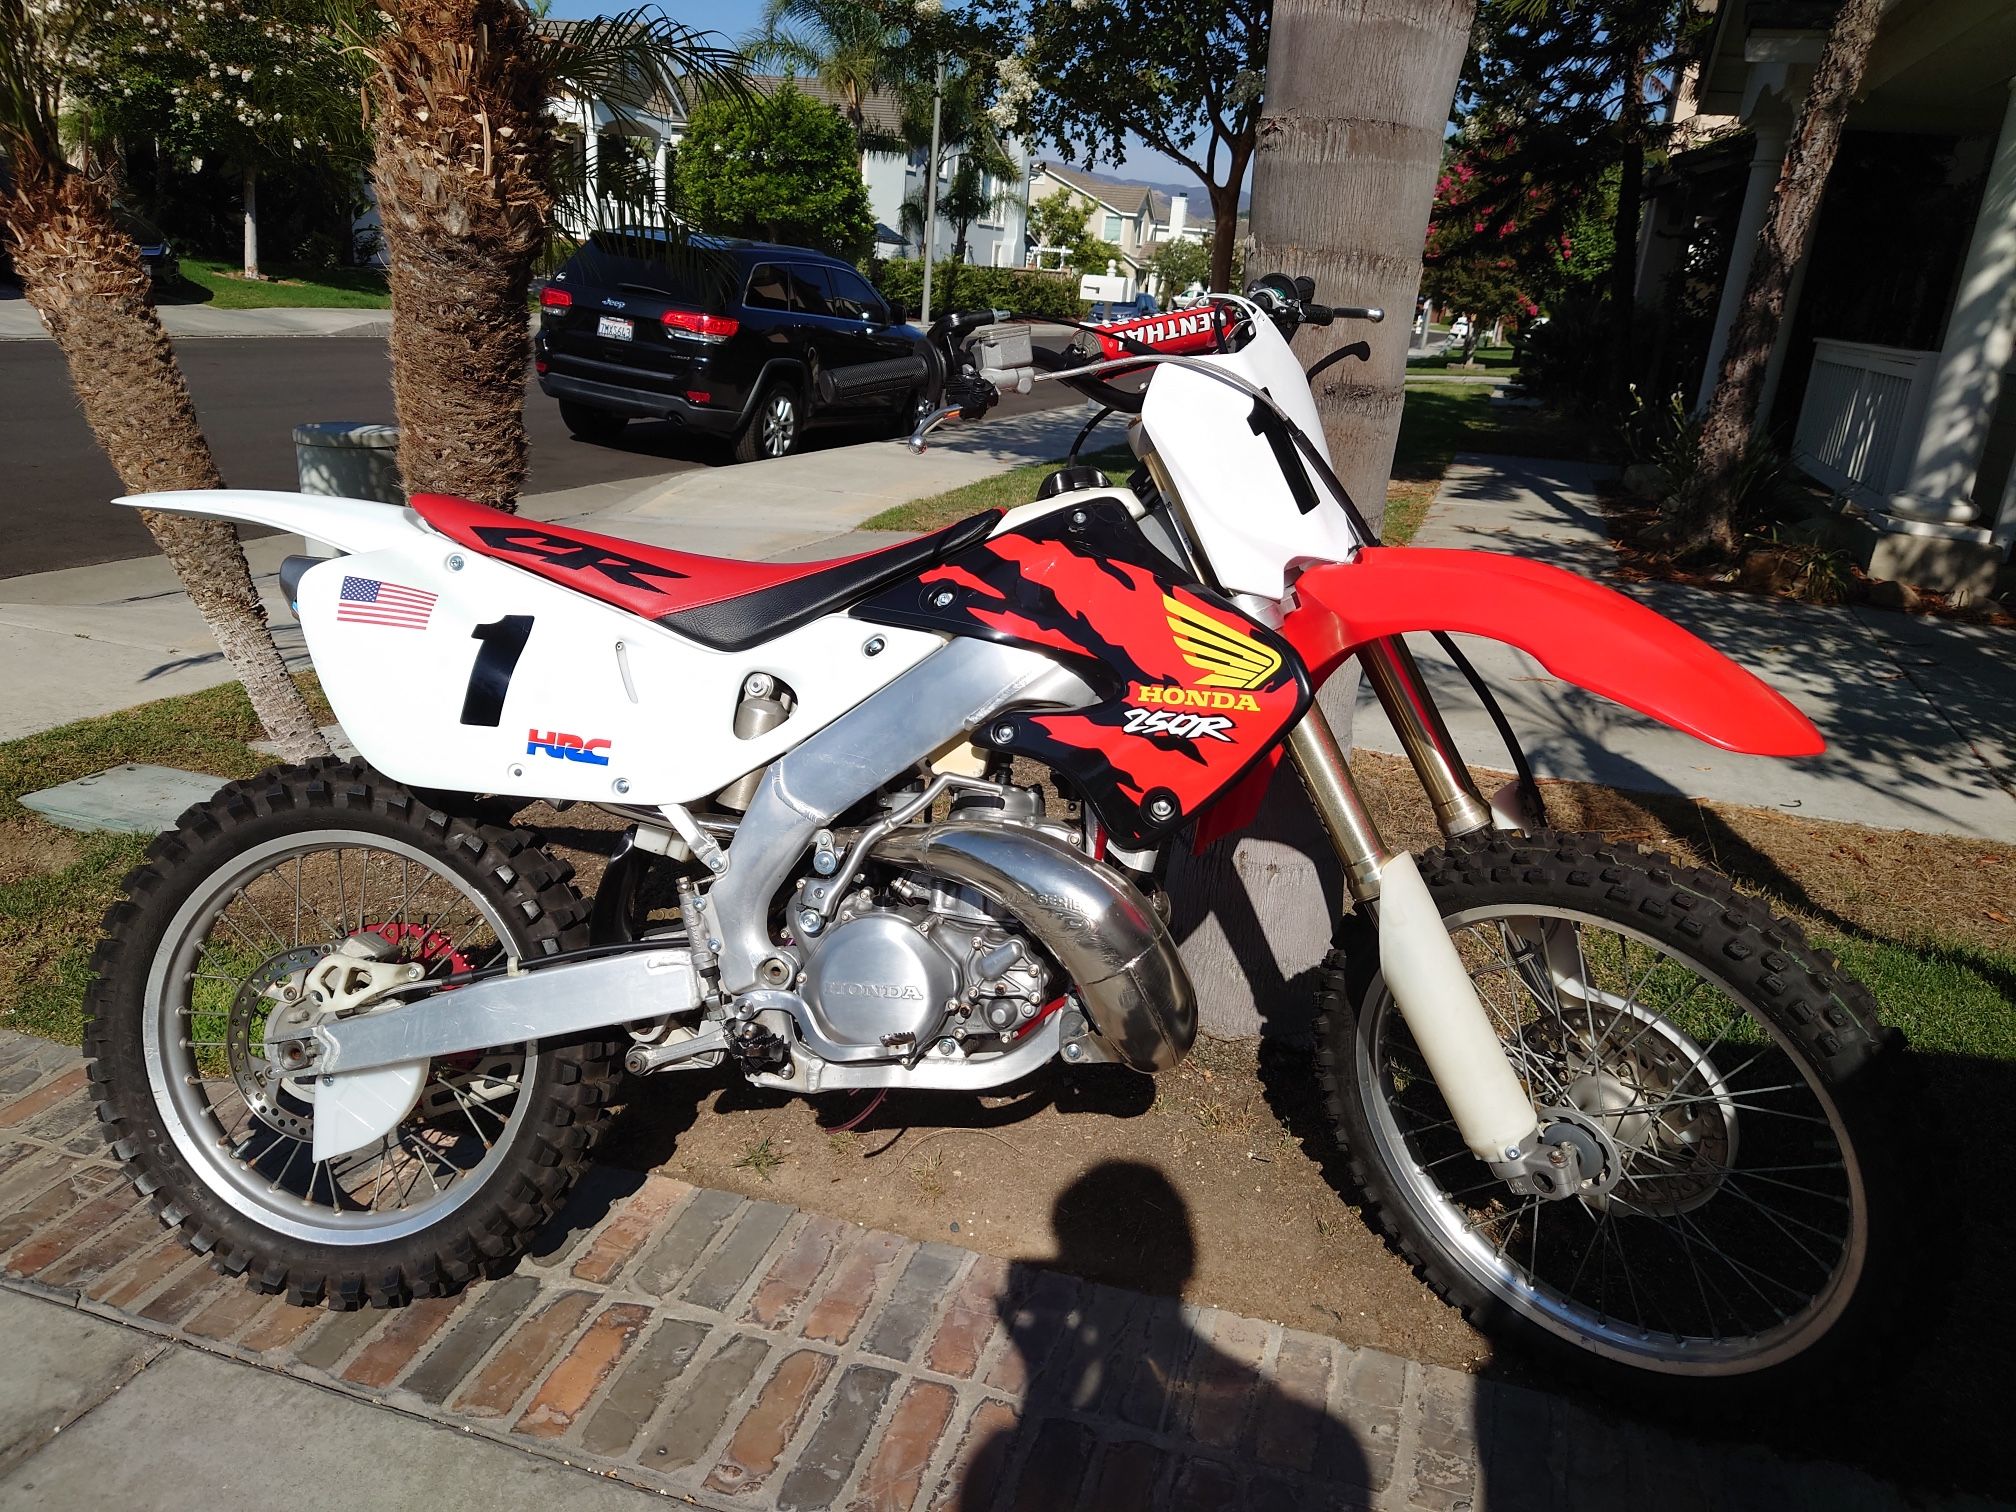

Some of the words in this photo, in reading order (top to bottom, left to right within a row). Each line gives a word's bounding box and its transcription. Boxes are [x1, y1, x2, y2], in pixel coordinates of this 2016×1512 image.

[603, 298, 625, 309] Jeep
[1247, 387, 1320, 515] 1
[469, 526, 692, 595] CR
[460, 614, 535, 727] 1
[1138, 685, 1261, 712] HONDA
[1123, 708, 1235, 742] 250R
[527, 729, 612, 766] HRC
[824, 981, 924, 1001] HONDA
